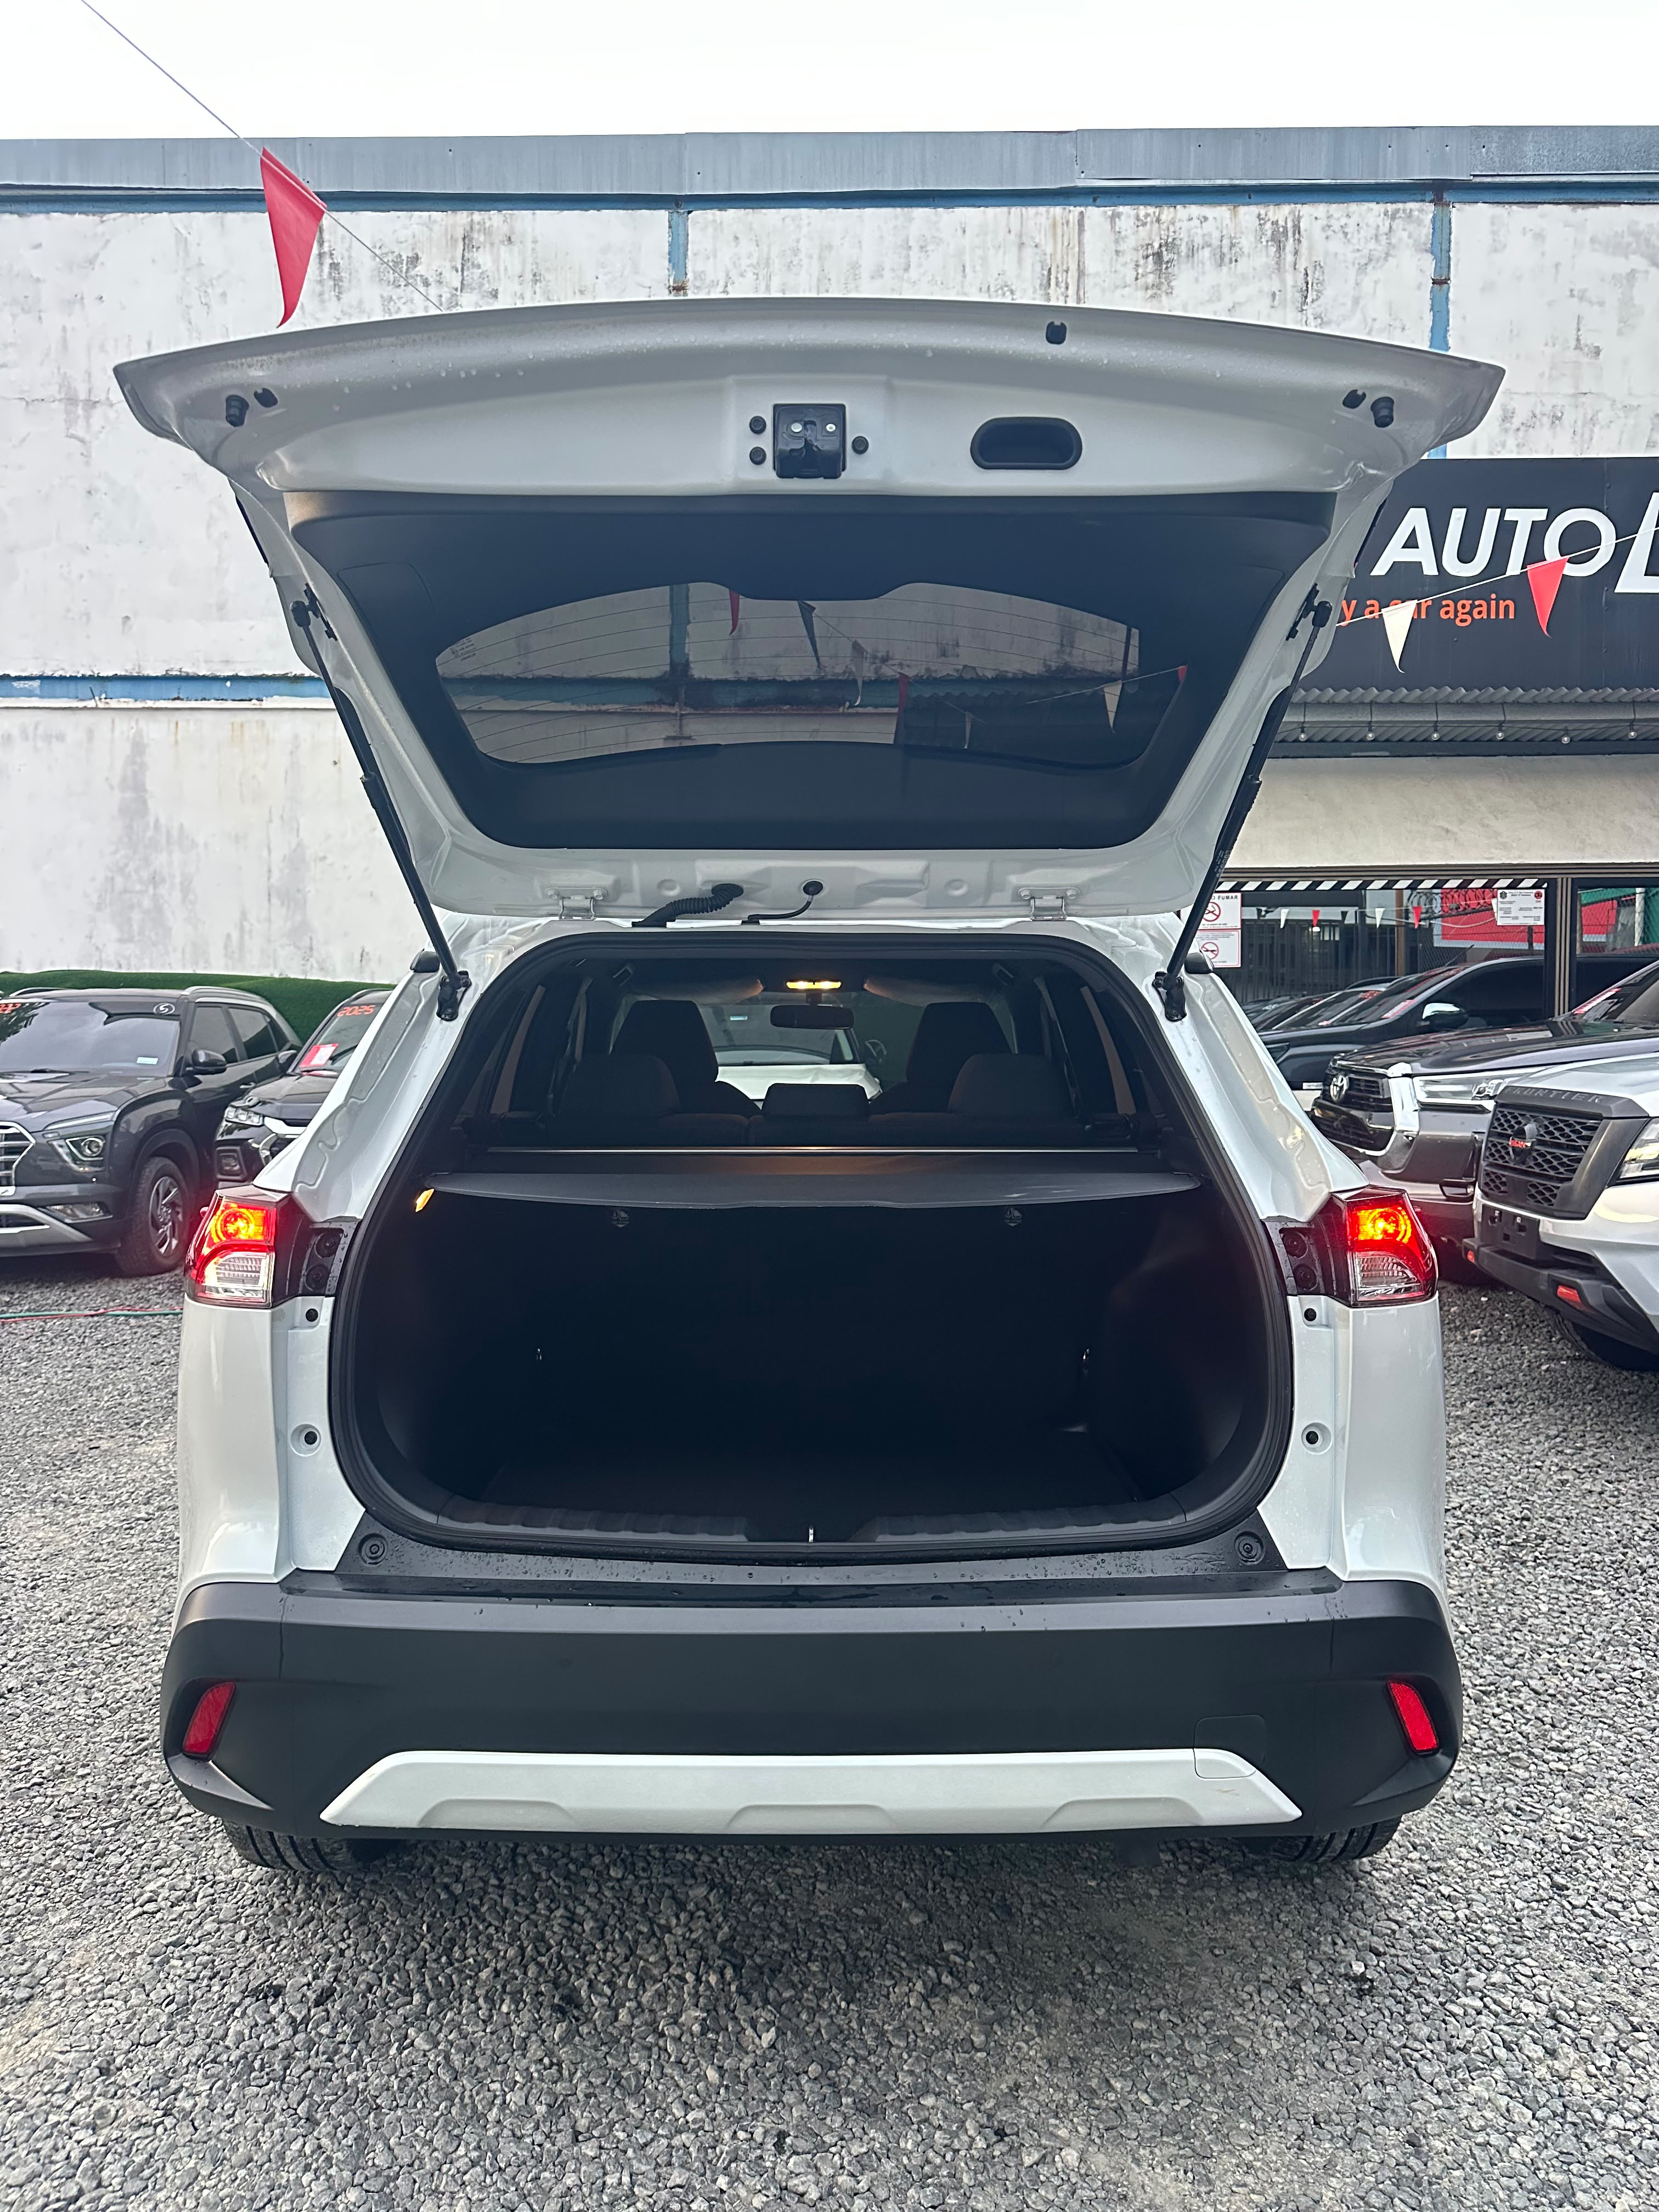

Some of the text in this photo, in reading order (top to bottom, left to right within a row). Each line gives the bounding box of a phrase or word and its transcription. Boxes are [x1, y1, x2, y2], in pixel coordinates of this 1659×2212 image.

[1370, 507, 1616, 577] AUTO
[1364, 600, 1380, 619] a
[1440, 593, 1515, 627] again
[337, 1005, 376, 1017] 2025
[1505, 1086, 1605, 1103] FRONTIER
